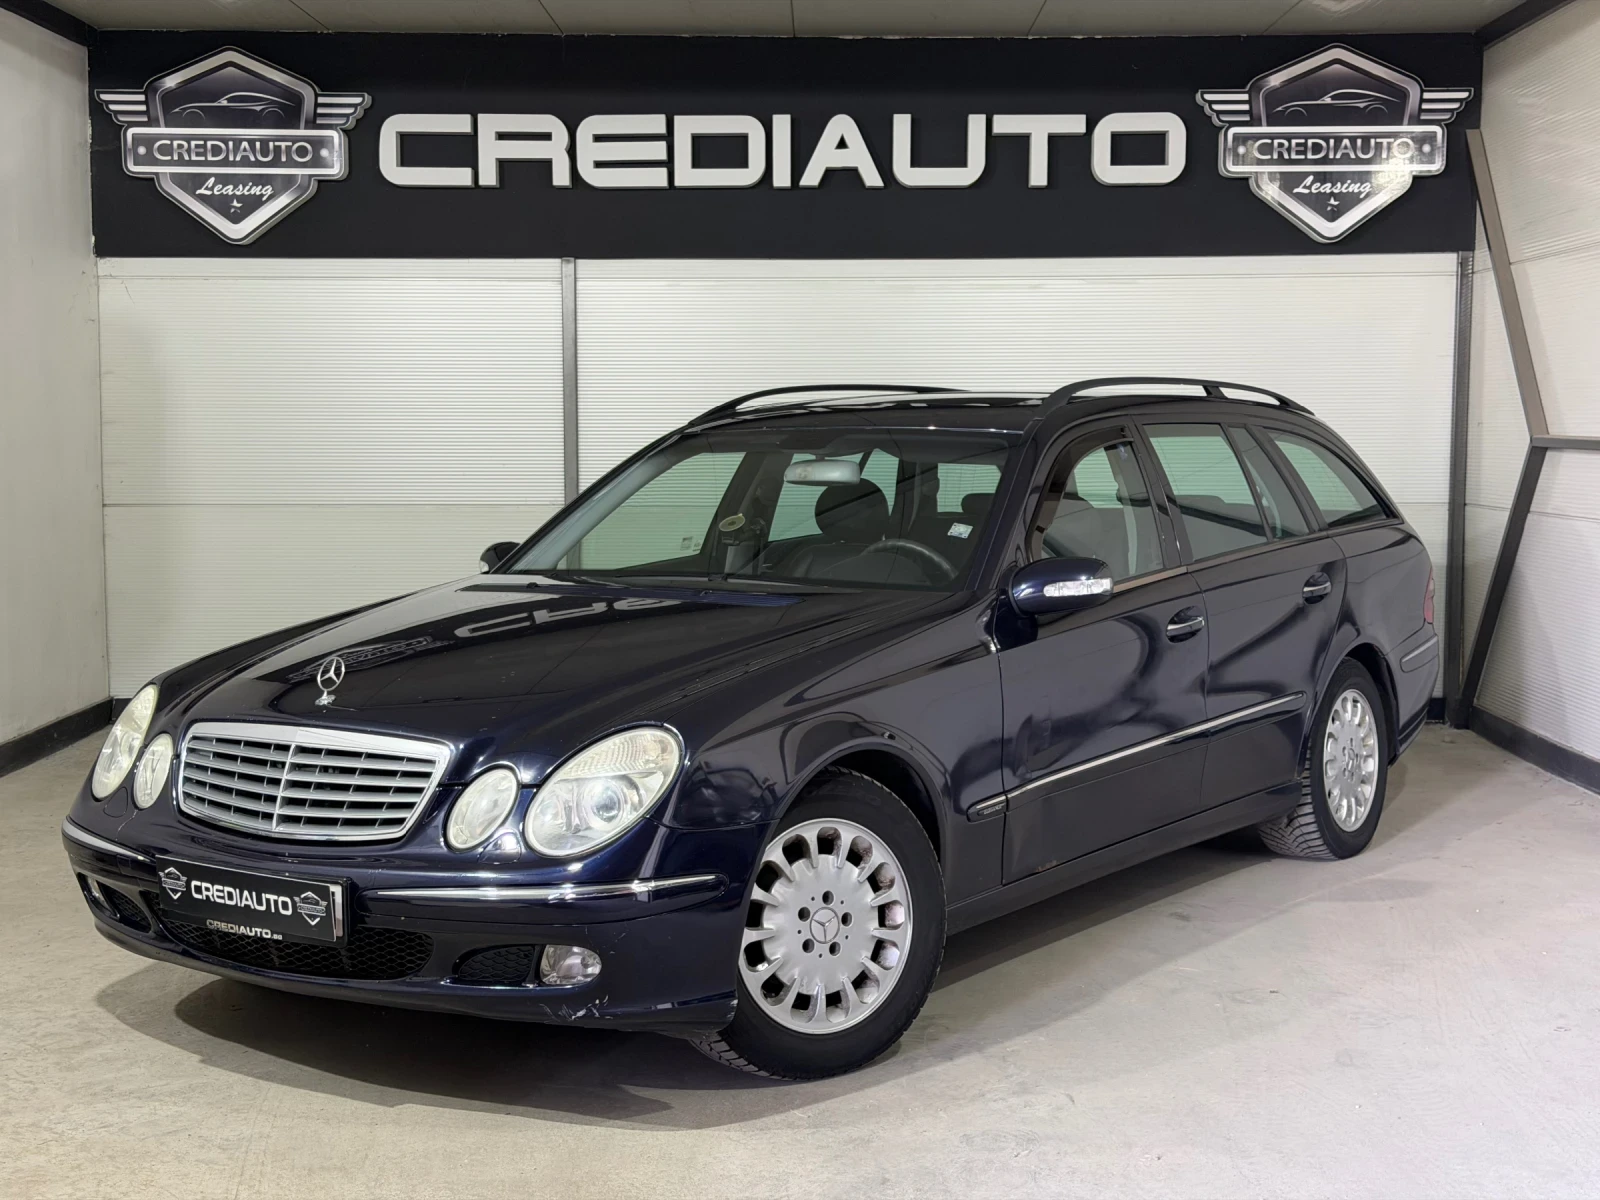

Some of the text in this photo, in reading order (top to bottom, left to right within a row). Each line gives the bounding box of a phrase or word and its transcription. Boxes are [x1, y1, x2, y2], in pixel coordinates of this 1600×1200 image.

[152, 139, 314, 163] CREDIAUTO
[378, 112, 1188, 190] CREDIAUTO
[1252, 137, 1416, 161] CREDIAUTO
[195, 177, 275, 202] Leasing
[1293, 175, 1373, 199] Leasing
[190, 880, 293, 916] CREDIAUTO
